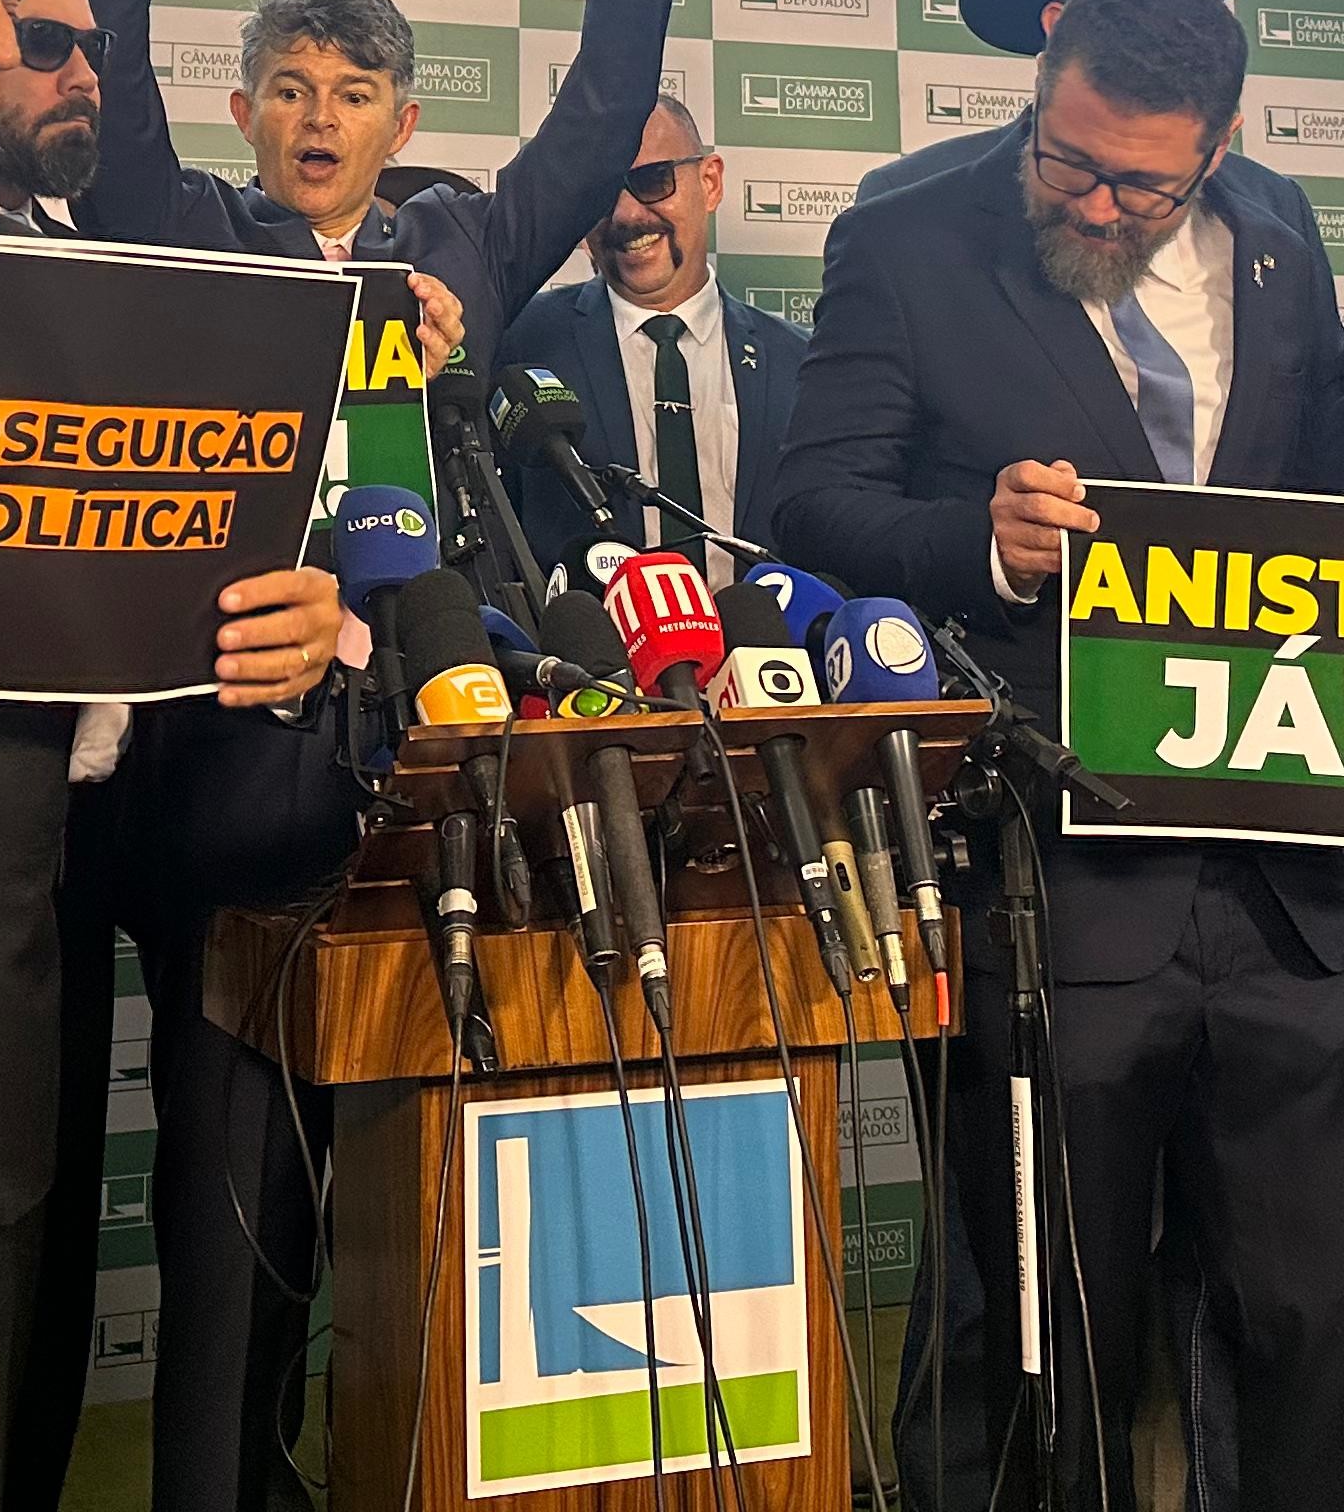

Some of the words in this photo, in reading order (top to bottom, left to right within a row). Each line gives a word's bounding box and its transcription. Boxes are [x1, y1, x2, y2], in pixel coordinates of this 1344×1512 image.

[1295, 16, 1342, 33] CÂMARA
[181, 49, 241, 66] CÂMARA
[181, 65, 242, 82] DEPUTA
[415, 64, 452, 78] MARA
[453, 66, 482, 80] DOS
[414, 77, 482, 94] PUTADOS
[784, 82, 837, 98] CÂMARA
[839, 86, 865, 100] DOS
[785, 97, 865, 113] DEPUTADOS
[966, 91, 1016, 108] CÂMARA
[967, 106, 1017, 121] DEPUTA
[787, 187, 840, 204] CÂMARA
[788, 203, 840, 217] DEPUTA
[659, 619, 720, 634] METRÓPOLES
[873, 1105, 900, 1121] DOS
